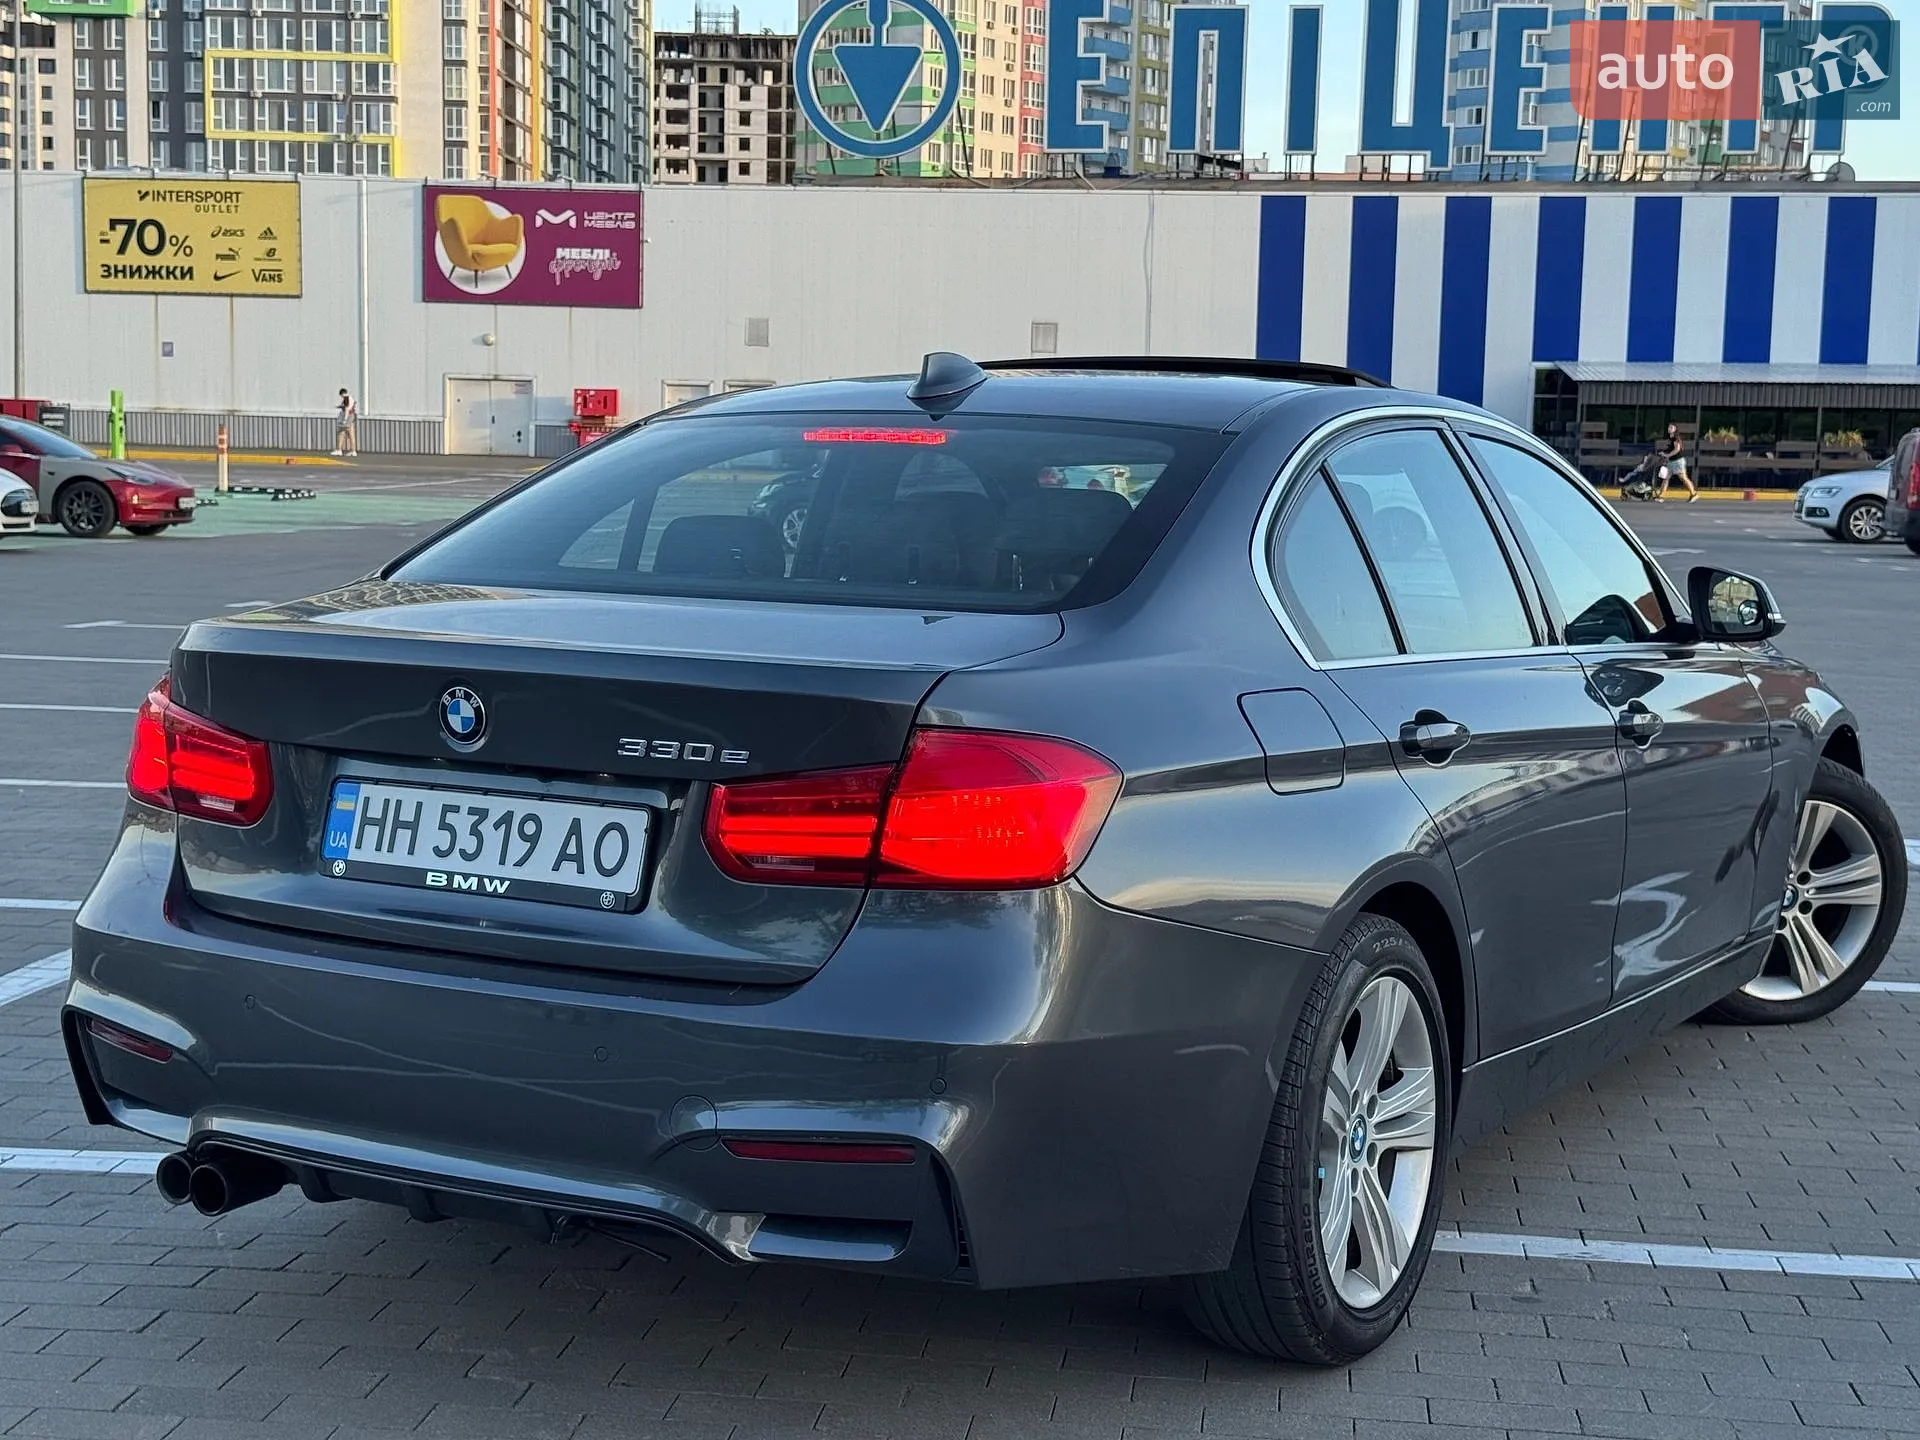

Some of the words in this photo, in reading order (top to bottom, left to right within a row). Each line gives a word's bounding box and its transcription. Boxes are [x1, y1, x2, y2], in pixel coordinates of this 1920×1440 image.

[152, 190, 241, 204] INTERSPORT
[195, 204, 240, 214] OUTLET
[100, 263, 194, 281] ЗНИЖКИ
[252, 268, 283, 284] VANS
[443, 689, 480, 708] BMW
[616, 737, 750, 764] 330e
[329, 830, 349, 850] UA
[354, 796, 424, 856] HH
[432, 804, 543, 868] 5319
[551, 817, 630, 878] AO
[425, 871, 511, 894] BMW
